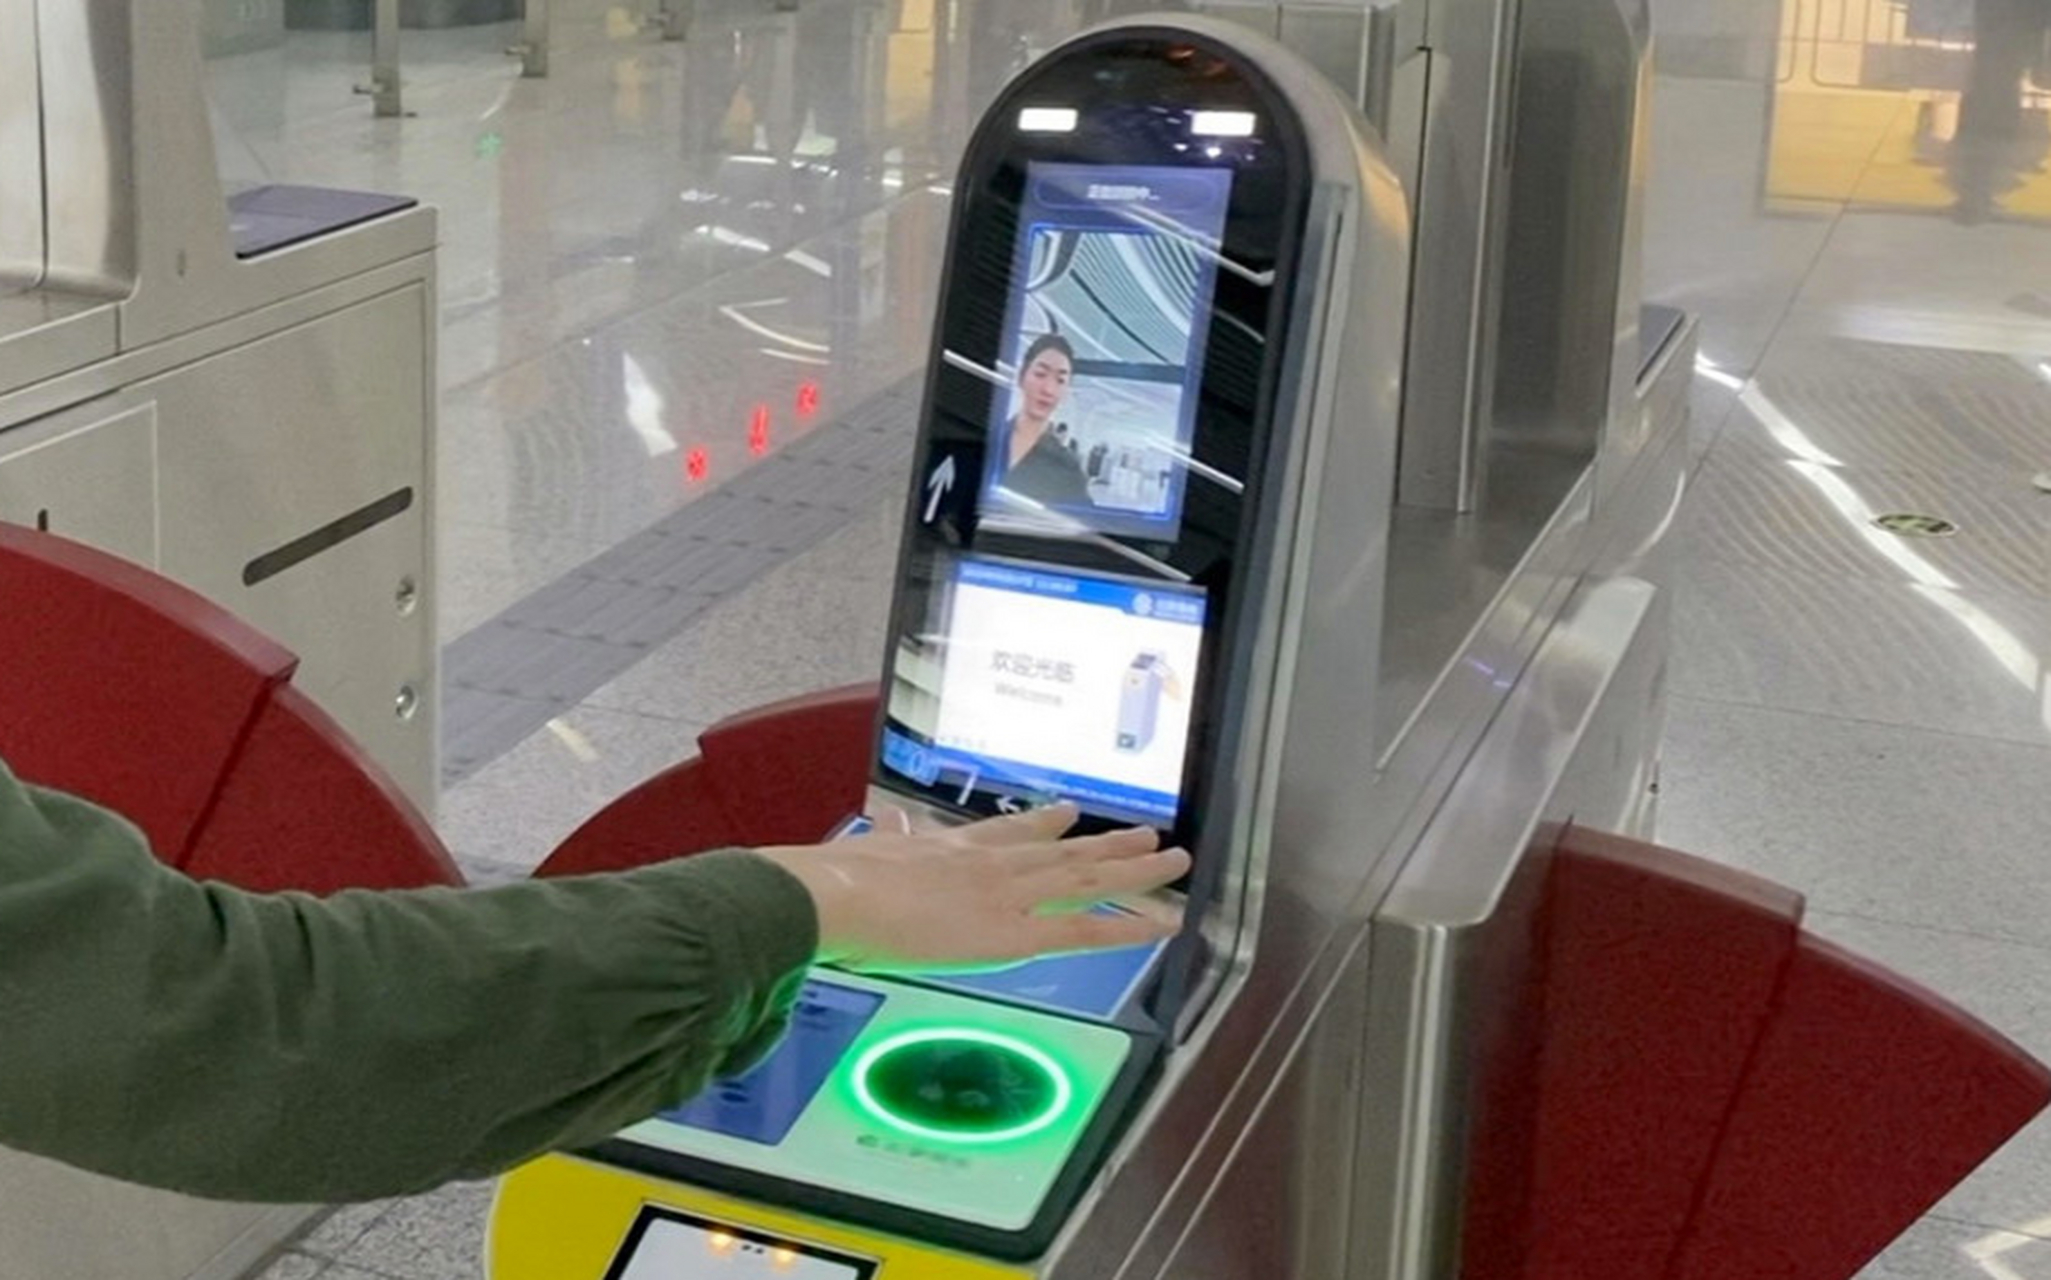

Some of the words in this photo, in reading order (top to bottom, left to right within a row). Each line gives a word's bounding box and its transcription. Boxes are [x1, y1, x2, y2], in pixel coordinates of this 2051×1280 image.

[991, 650, 1077, 682] 欢迎光临
[995, 682, 1062, 705] Welcome
